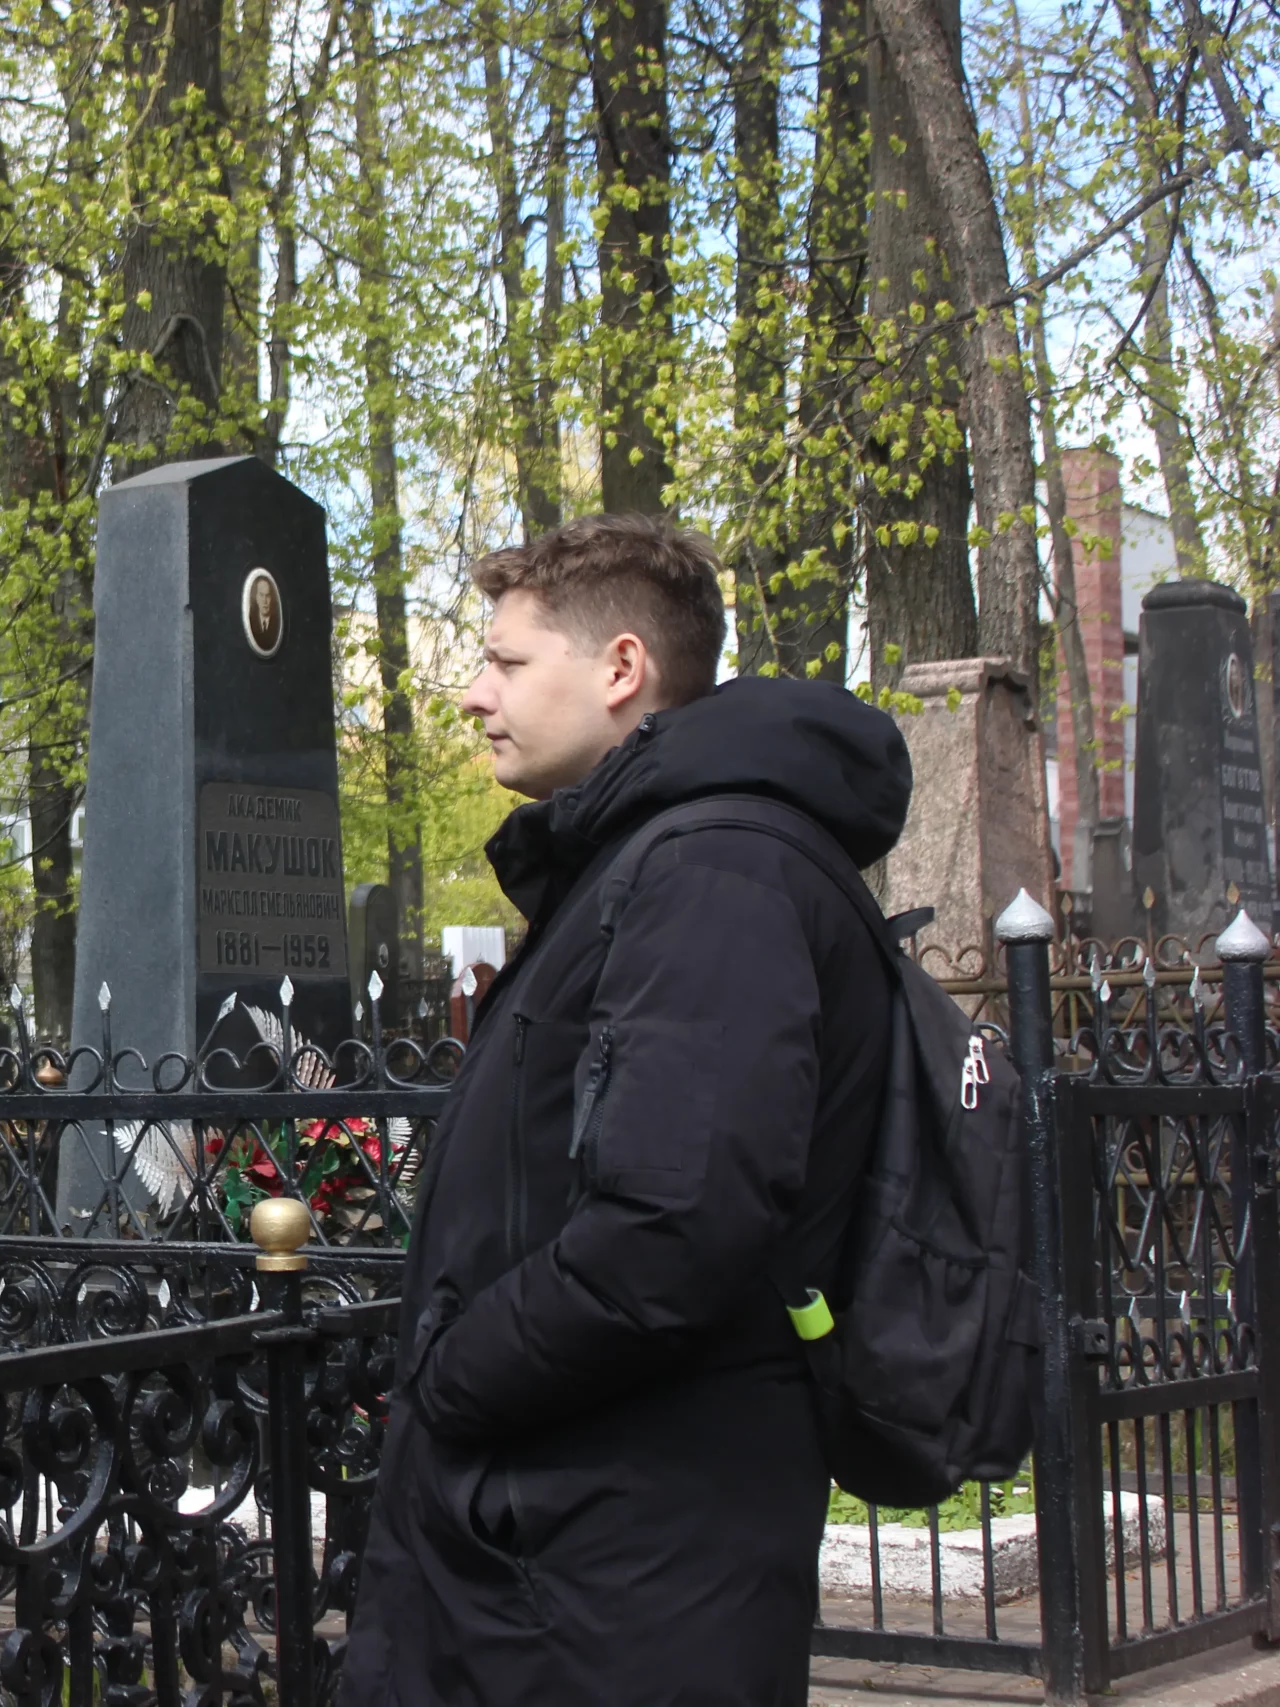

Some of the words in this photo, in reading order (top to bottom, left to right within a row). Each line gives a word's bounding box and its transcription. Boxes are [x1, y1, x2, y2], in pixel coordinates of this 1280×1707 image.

[228, 794, 302, 822] АКАДЕМИК
[205, 830, 337, 879] МАКУШОК
[202, 888, 257, 917] МАРКЕЛЛ
[260, 891, 341, 921] ЕМЕЛЬЯНОВИЧ
